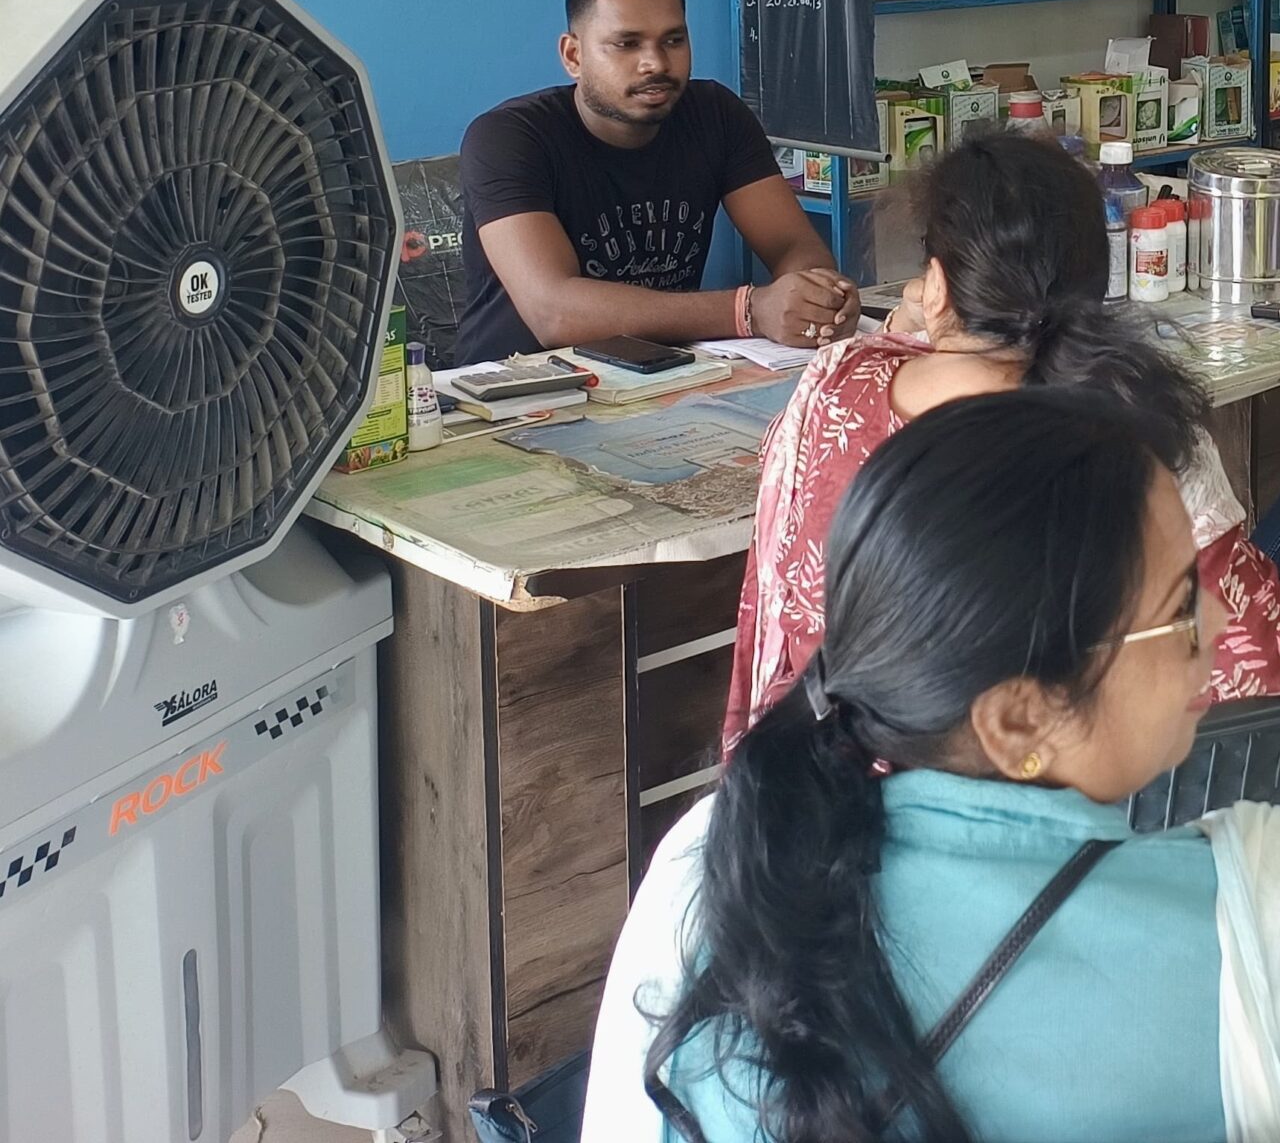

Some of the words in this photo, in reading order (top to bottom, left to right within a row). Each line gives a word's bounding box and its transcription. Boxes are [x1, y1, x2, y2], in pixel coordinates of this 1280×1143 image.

[191, 272, 208, 292] OK
[186, 290, 212, 304] TESTED
[108, 740, 227, 837] ROCK
